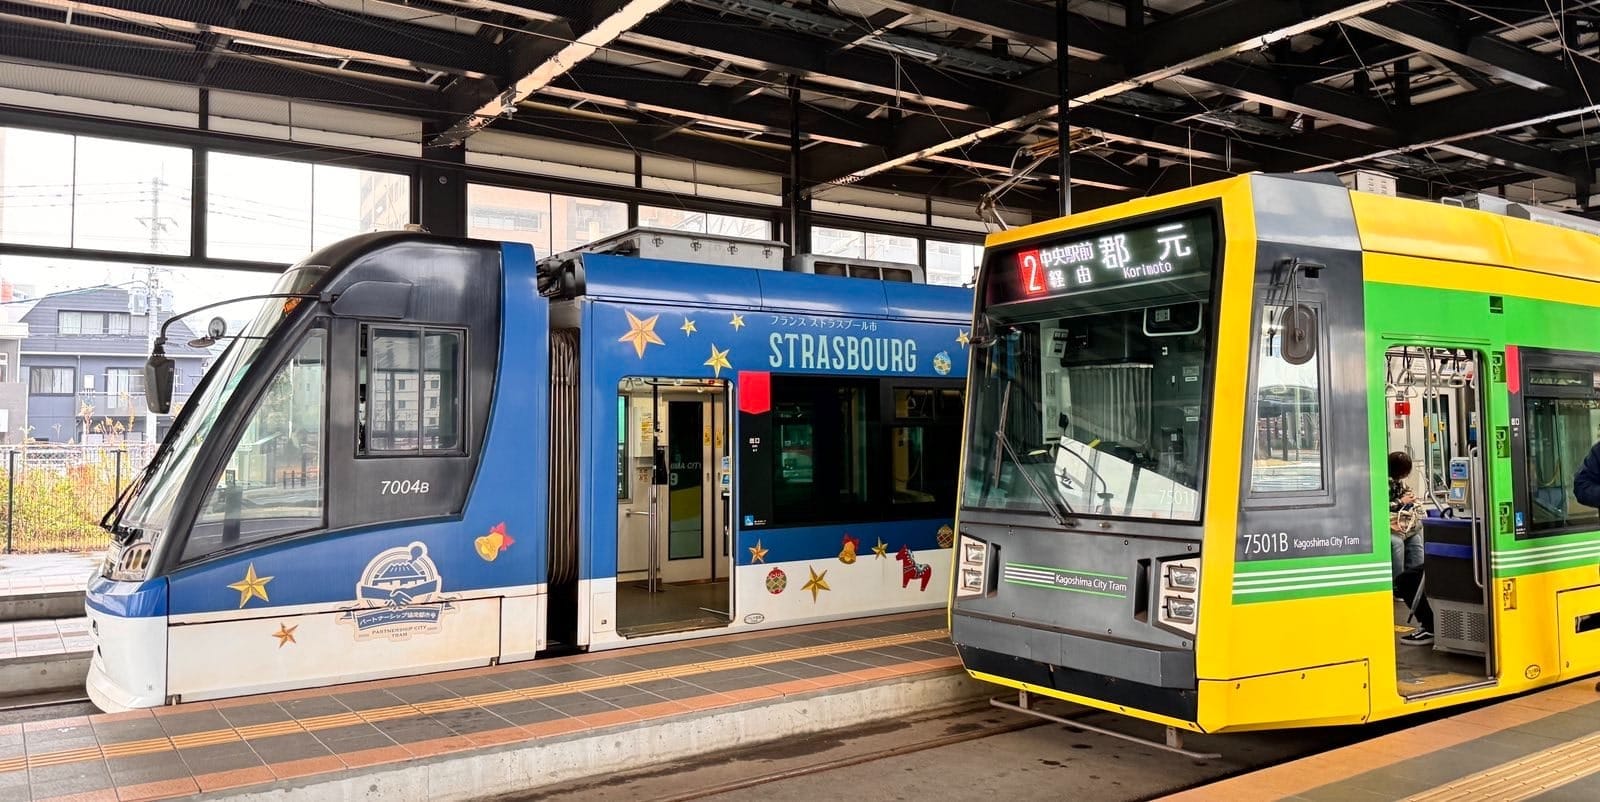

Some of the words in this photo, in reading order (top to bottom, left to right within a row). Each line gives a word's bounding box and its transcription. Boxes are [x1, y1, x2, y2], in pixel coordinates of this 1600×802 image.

[1040, 241, 1094, 267] 中央駅前
[1099, 223, 1191, 269] 郡元
[1023, 255, 1042, 291] 2
[1049, 265, 1092, 288] 経由
[1123, 261, 1172, 279] Korimoto
[771, 316, 806, 326] フランス
[811, 318, 877, 331] ストラスブール市
[769, 332, 917, 372] STRASBOURG
[381, 479, 430, 495] 7004B
[1243, 532, 1289, 554] 7501B
[1293, 538, 1330, 550] Kagoshima
[1330, 536, 1343, 547] City
[1343, 535, 1360, 545] Tram
[1055, 574, 1092, 587] Kagoshima
[1093, 578, 1107, 591] City
[1109, 581, 1127, 591] Tram
